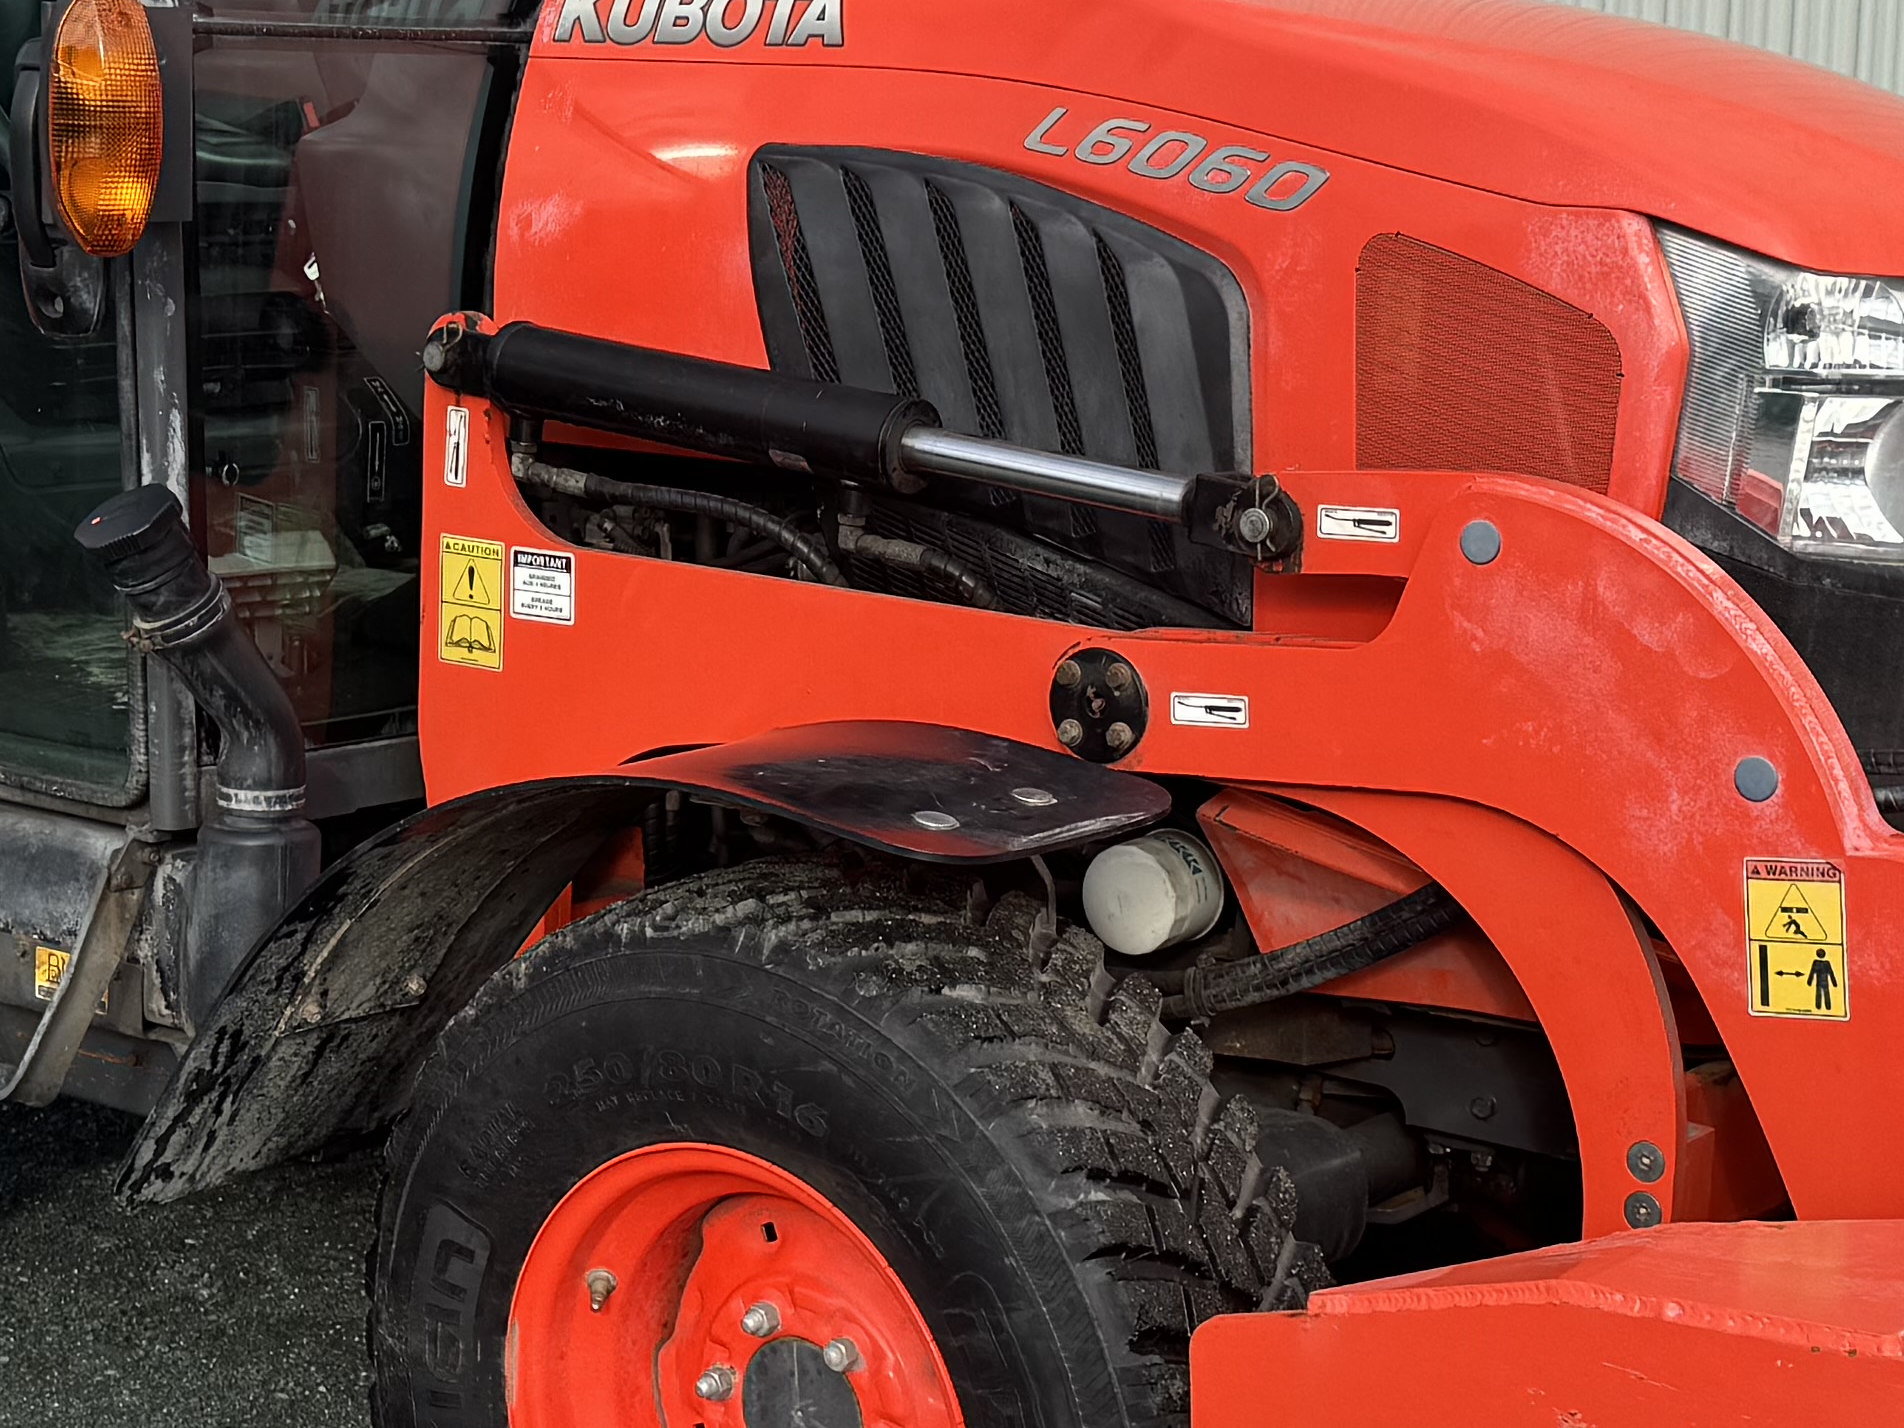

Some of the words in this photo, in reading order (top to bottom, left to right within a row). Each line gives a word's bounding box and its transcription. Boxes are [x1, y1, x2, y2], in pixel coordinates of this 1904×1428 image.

[1024, 106, 1329, 212] L6060
[453, 542, 500, 558] CAUTION
[517, 553, 567, 571] IMPORTANT
[1764, 864, 1837, 879] WARNING
